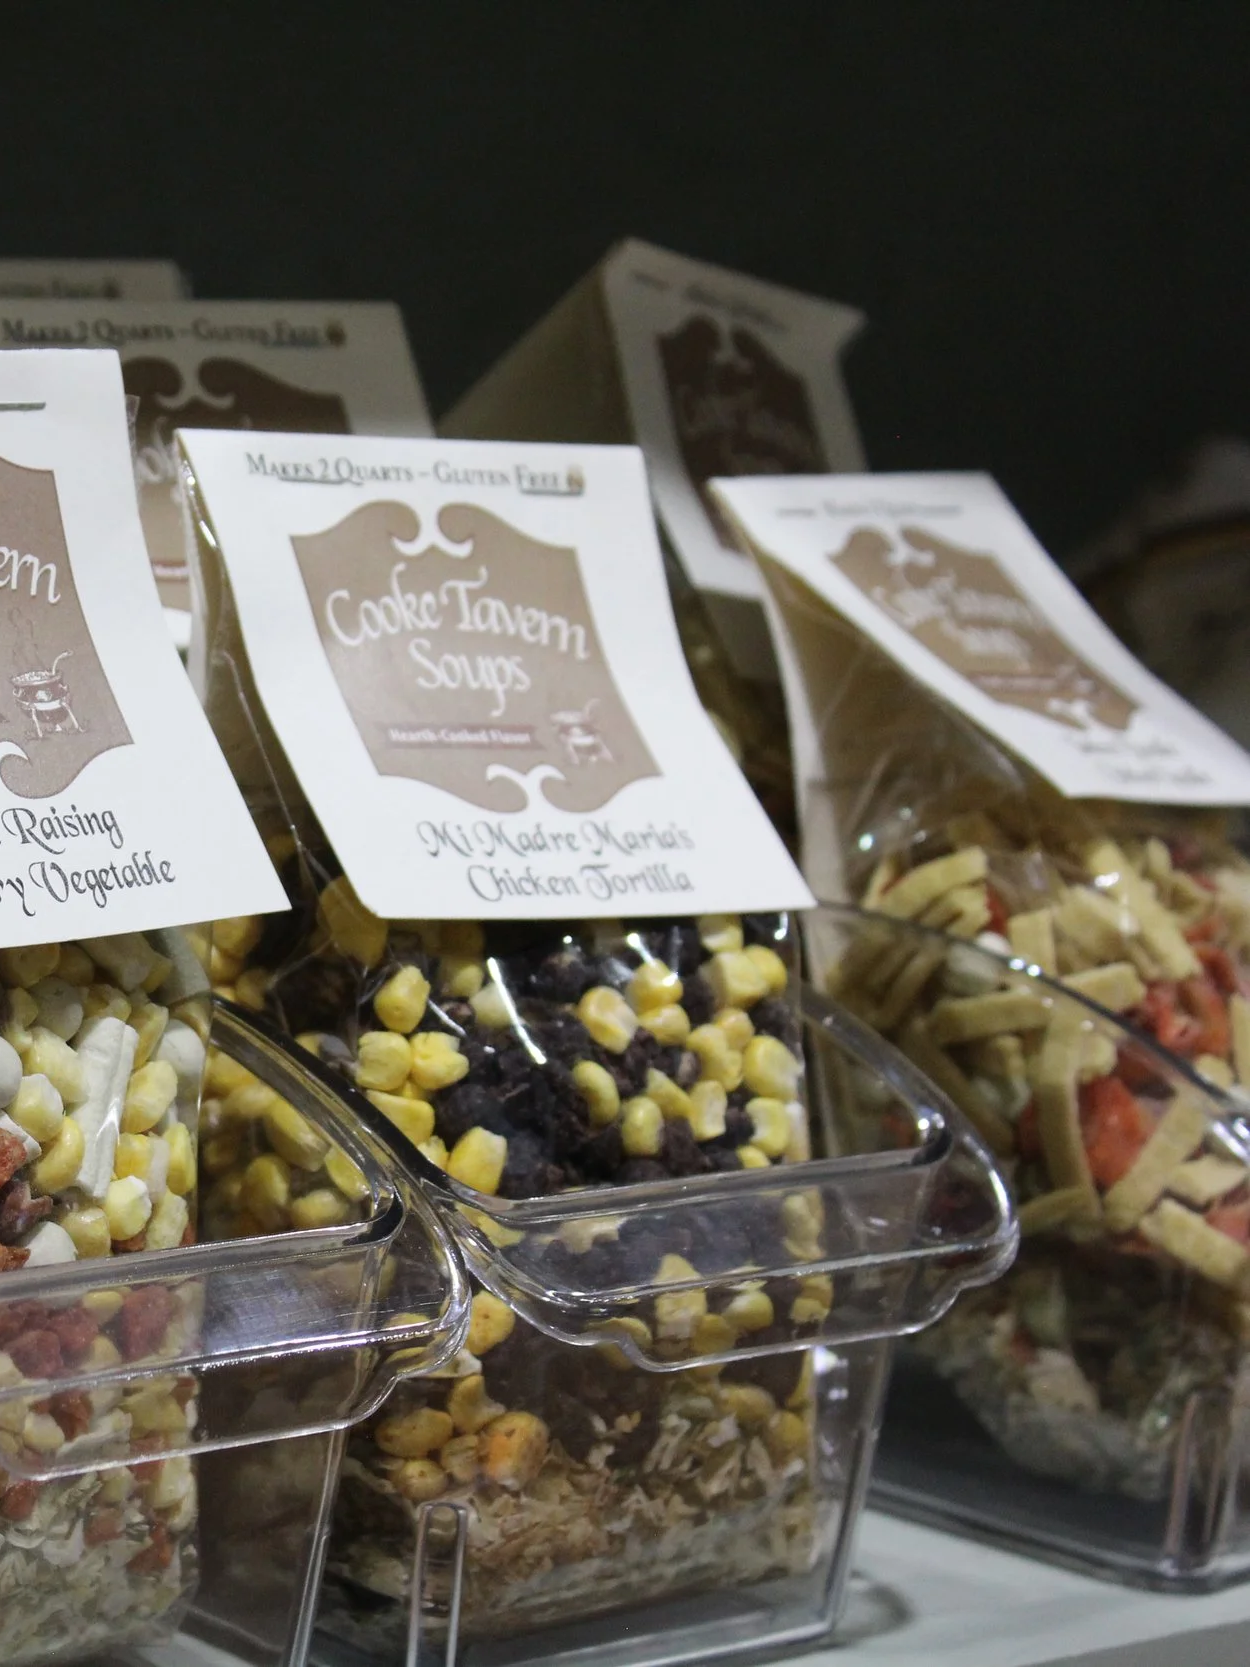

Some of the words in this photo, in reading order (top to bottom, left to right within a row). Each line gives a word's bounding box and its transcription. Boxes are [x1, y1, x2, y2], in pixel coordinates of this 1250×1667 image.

[245, 452, 313, 477] MAKES
[318, 458, 329, 478] 2
[334, 457, 412, 486] QUARTS
[326, 562, 443, 646] Cooke
[439, 565, 590, 660] Tavern
[408, 638, 531, 717] Soups
[1, 804, 124, 855] Raising
[416, 820, 473, 857] Mi
[472, 820, 580, 857] Madre
[580, 819, 696, 857] Maria's
[28, 850, 176, 908] Vegetable
[467, 864, 581, 902] Chicken
[579, 863, 695, 901] Tortilla
